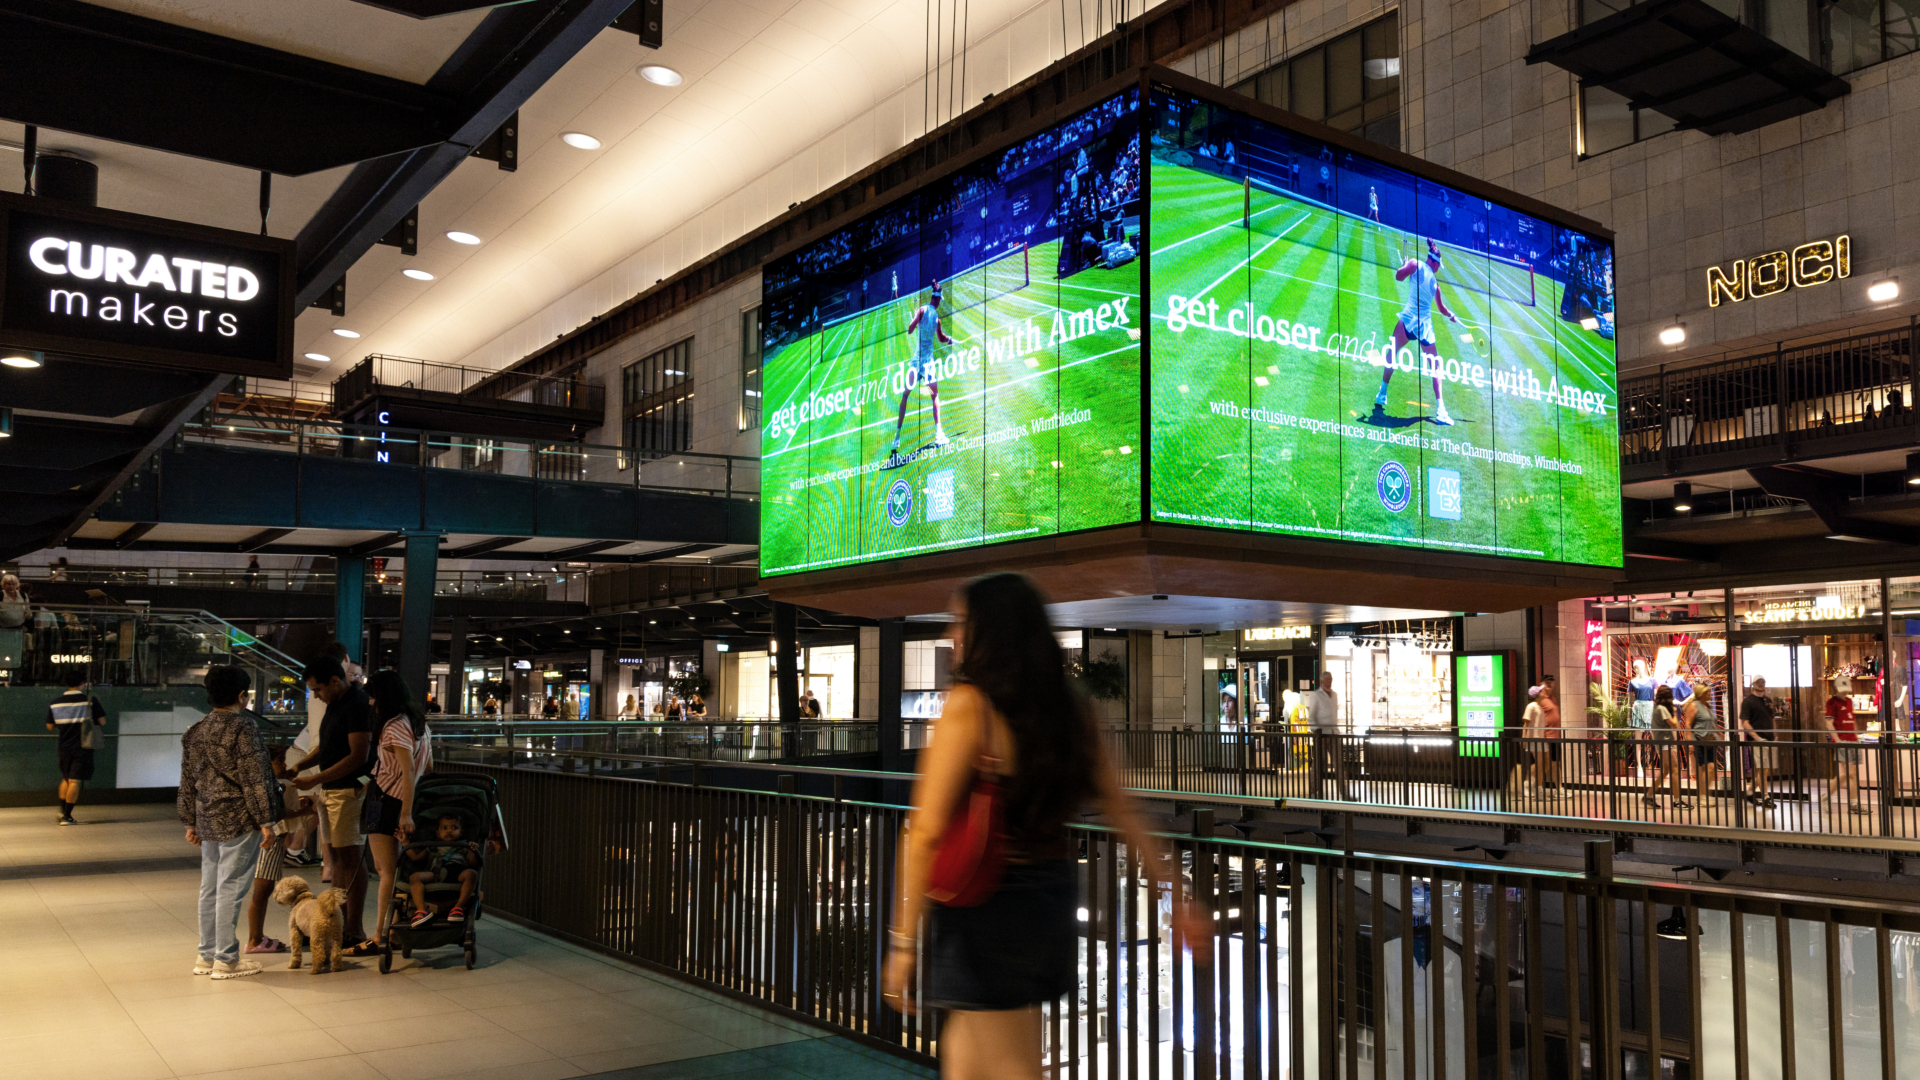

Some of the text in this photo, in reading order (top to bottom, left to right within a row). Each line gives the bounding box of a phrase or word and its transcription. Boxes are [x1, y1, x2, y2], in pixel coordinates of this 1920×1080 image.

[29, 237, 260, 302] CURATED
[1706, 235, 1851, 307] NOCI
[49, 288, 238, 337] makers
[771, 296, 1130, 438] get closer and do more with Amex
[1167, 294, 1607, 415] get closer and do more with Amex
[789, 476, 804, 491] with
[806, 469, 837, 487] exclusive
[837, 460, 880, 481] experiences
[881, 454, 895, 470] and
[896, 447, 928, 466] benefits
[939, 442, 954, 456] The
[956, 423, 1029, 450] Championships,
[1031, 408, 1091, 434] Wimbledon
[1210, 400, 1582, 475] with exclusive experiences and benefits at The Championships, Wimbledon
[1437, 477, 1461, 498] AM
[1441, 494, 1461, 513] EX
[1744, 605, 1856, 624] SCAMP & DUDE
